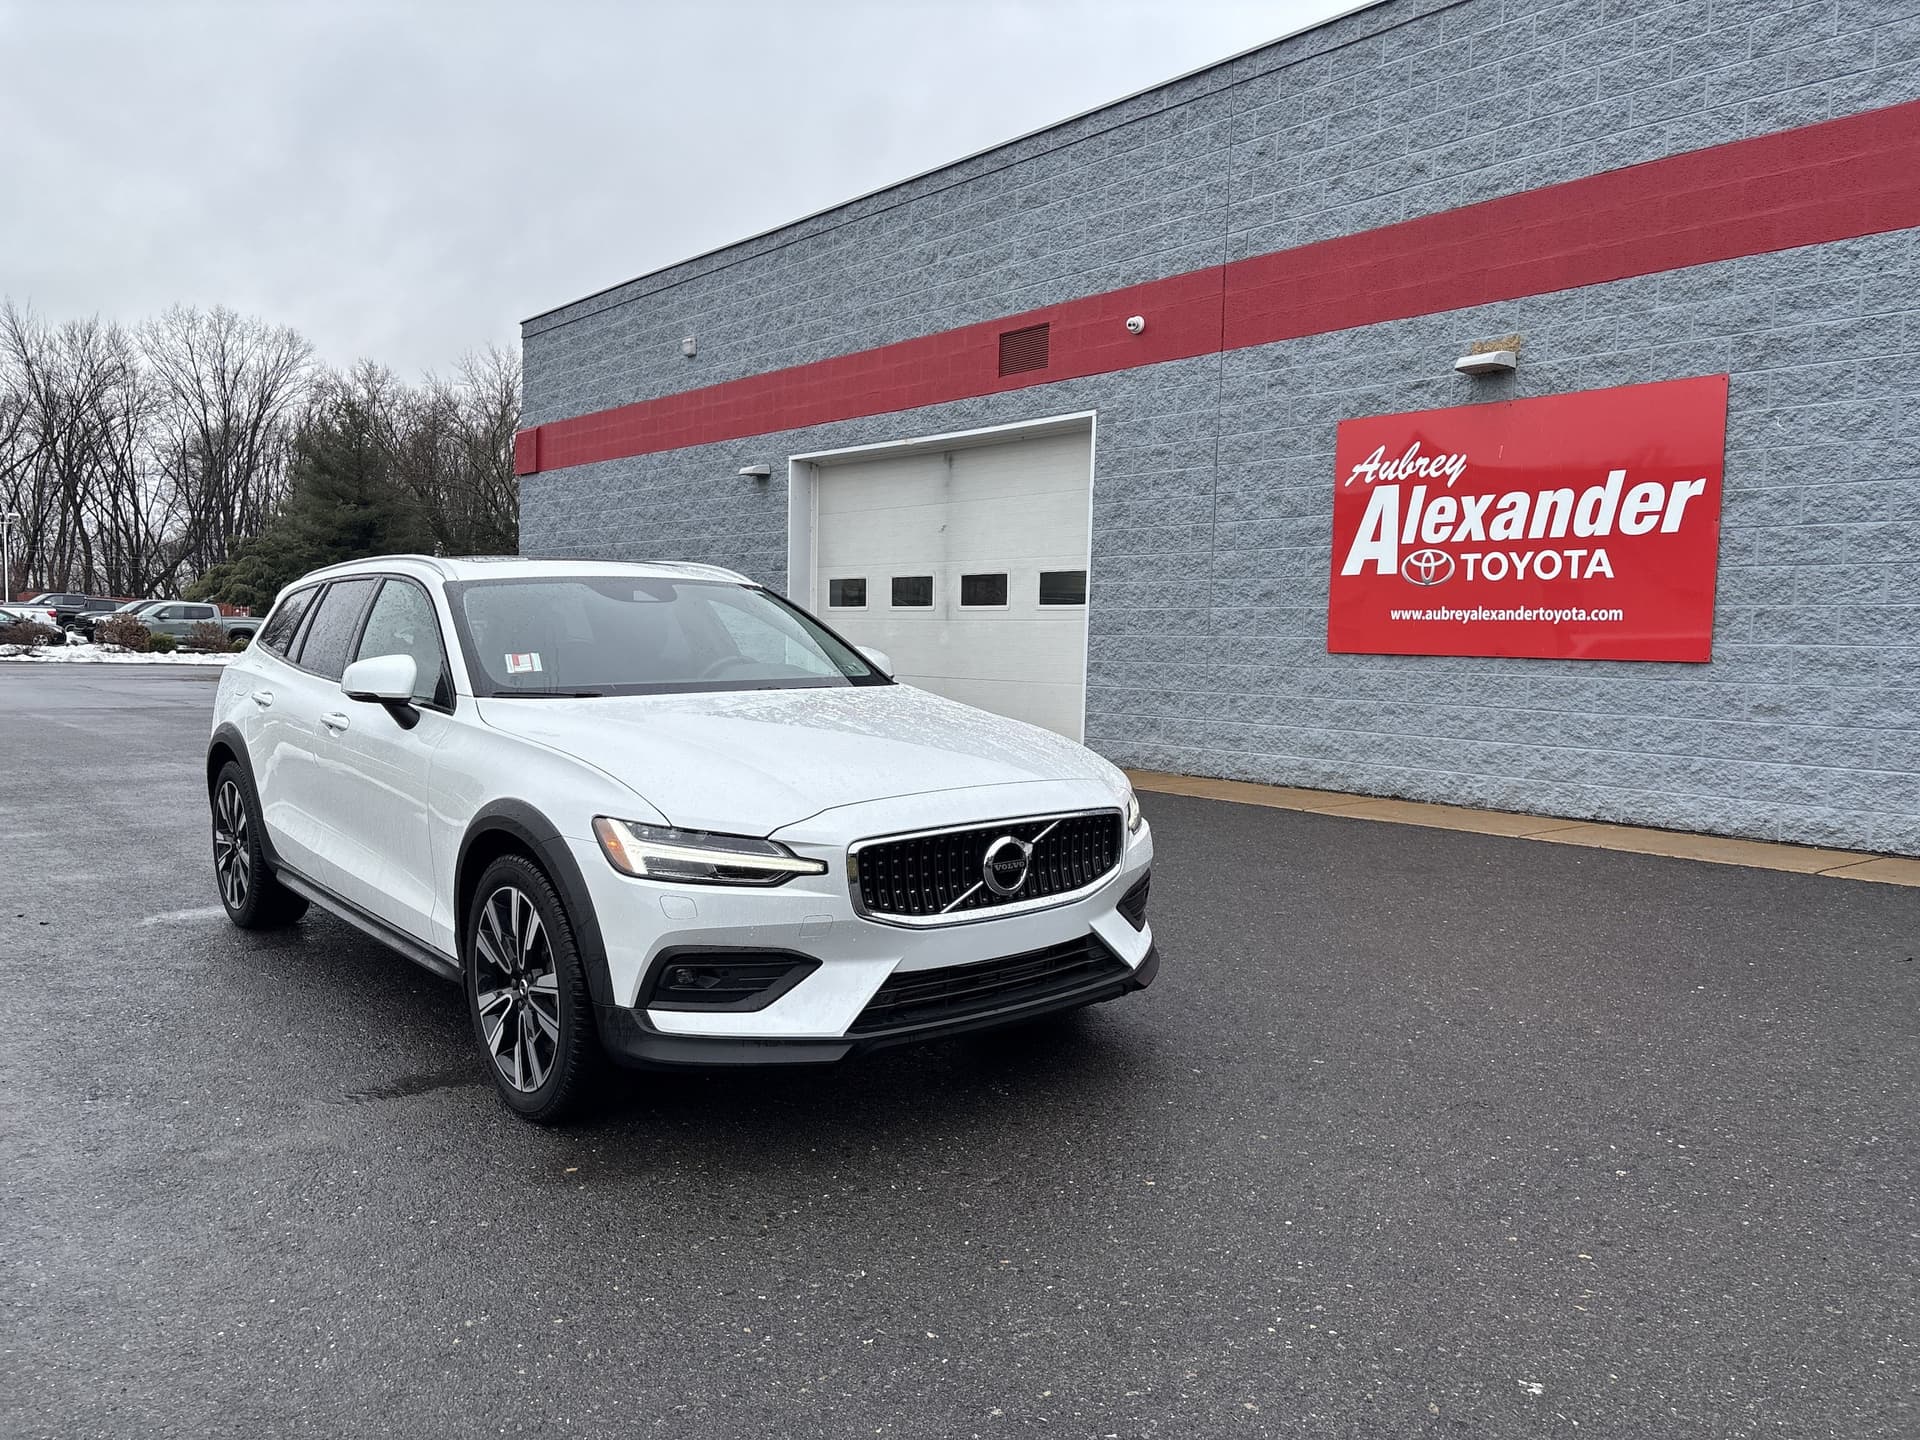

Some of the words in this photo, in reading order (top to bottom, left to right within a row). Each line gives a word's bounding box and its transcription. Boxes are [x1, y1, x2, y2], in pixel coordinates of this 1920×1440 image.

[1345, 441, 1467, 488] Aubrey
[1340, 470, 1707, 576] Alexander
[1460, 548, 1615, 581] TOYOTA
[1390, 606, 1624, 624] www.aubreyalexandertoyota.com
[994, 861, 1025, 871] VOLVO
